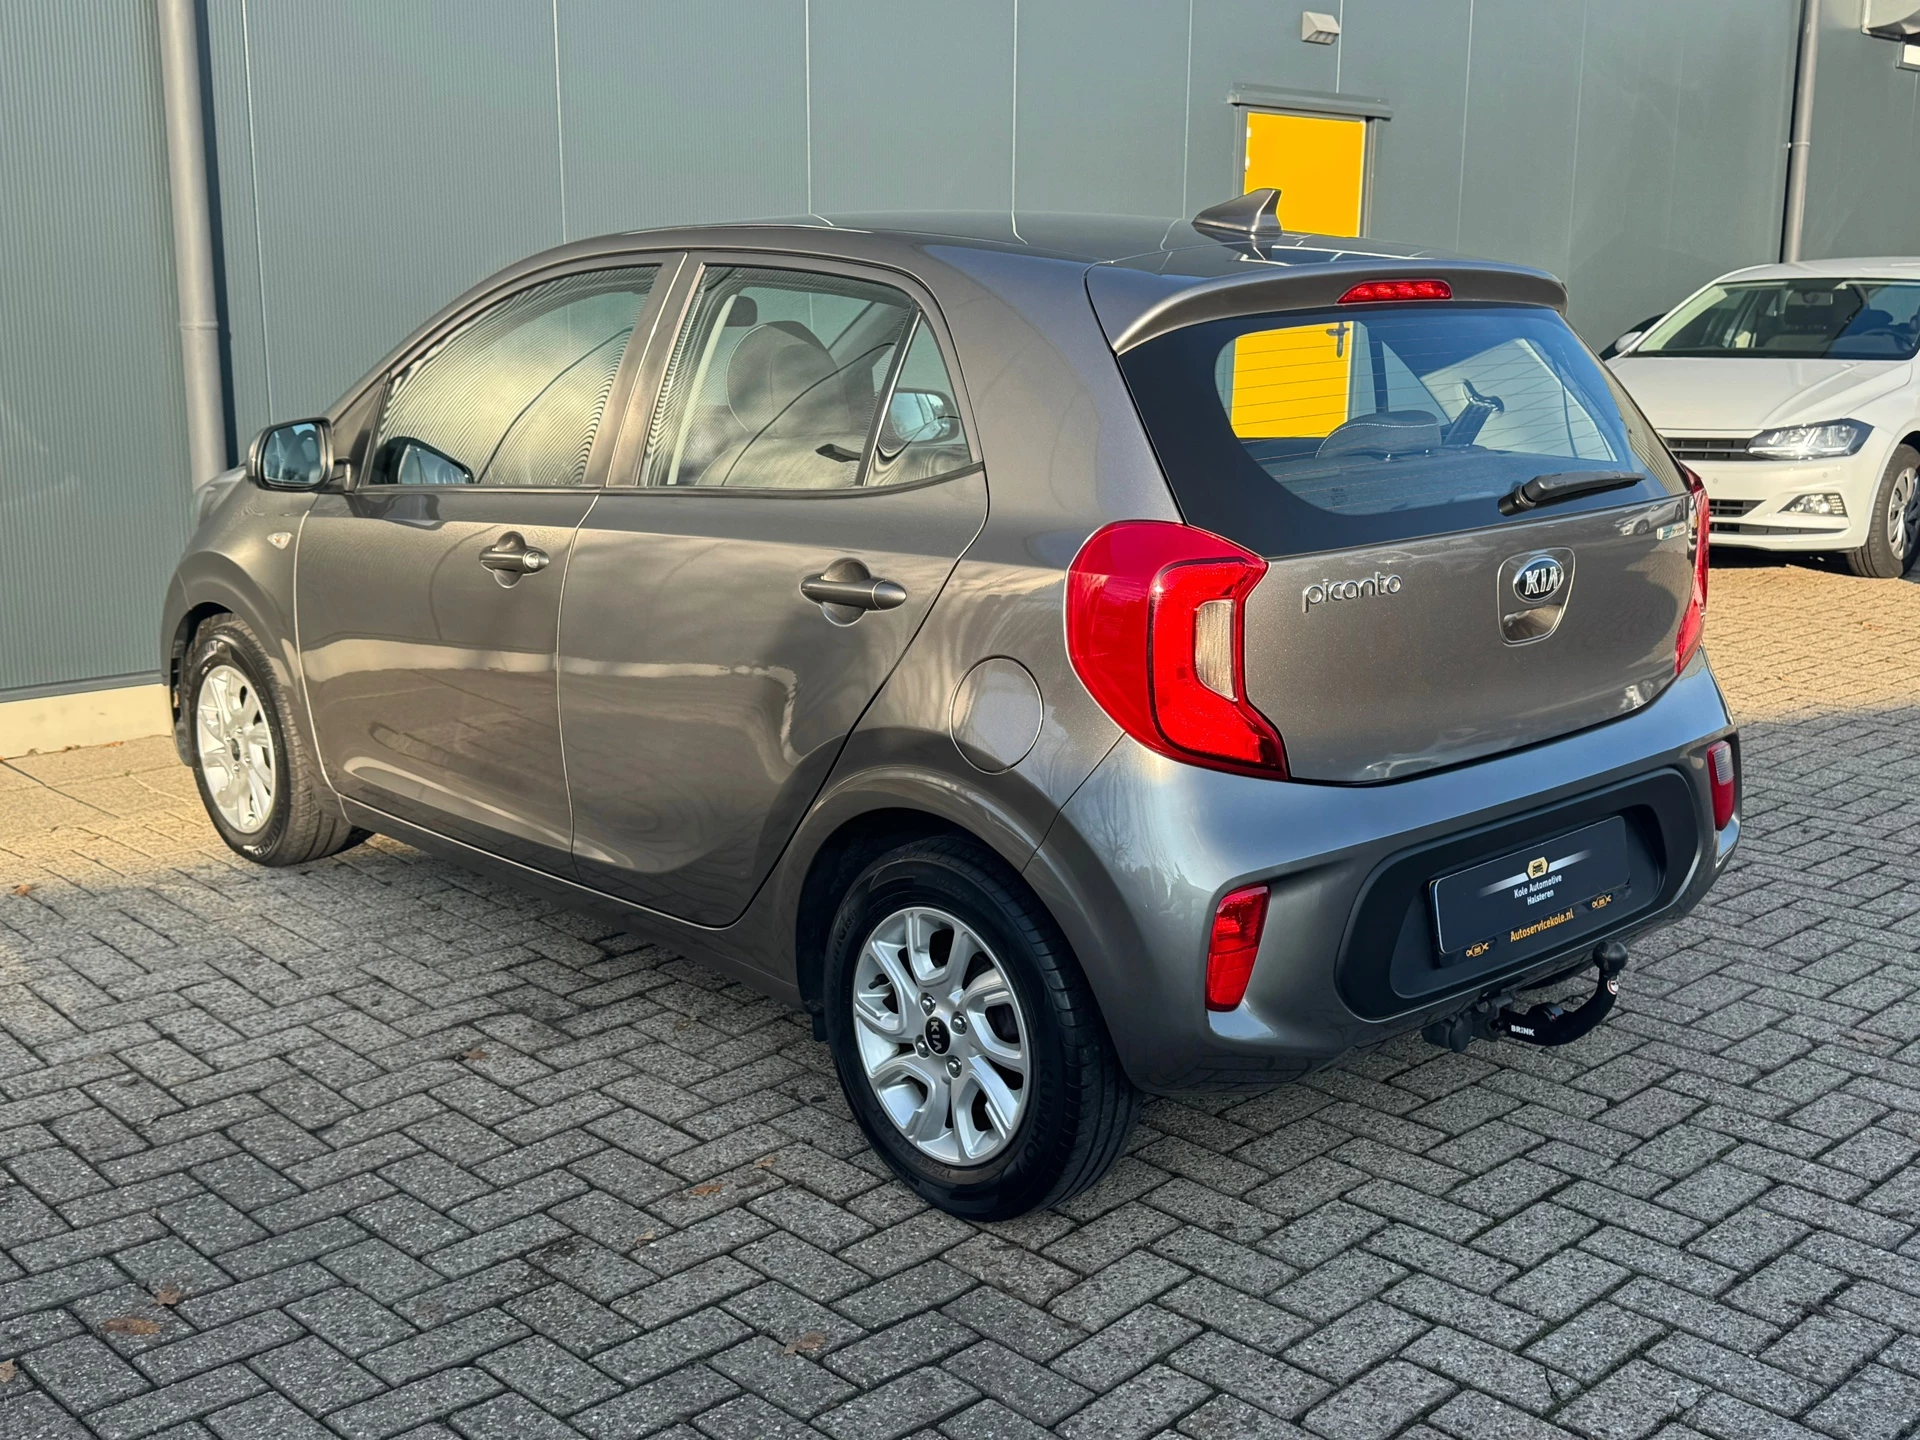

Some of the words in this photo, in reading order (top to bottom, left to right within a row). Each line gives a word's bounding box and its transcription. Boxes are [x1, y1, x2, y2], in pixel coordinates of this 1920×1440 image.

[1302, 571, 1403, 614] picanto
[1524, 565, 1560, 597] KIA
[1513, 887, 1528, 899] Kole
[1529, 874, 1562, 892] Automotive
[1527, 889, 1554, 905] Halsteren
[1510, 908, 1574, 942] Autoservicekole.nl
[930, 1021, 942, 1051] KIA
[1511, 1025, 1535, 1036] BRINK
